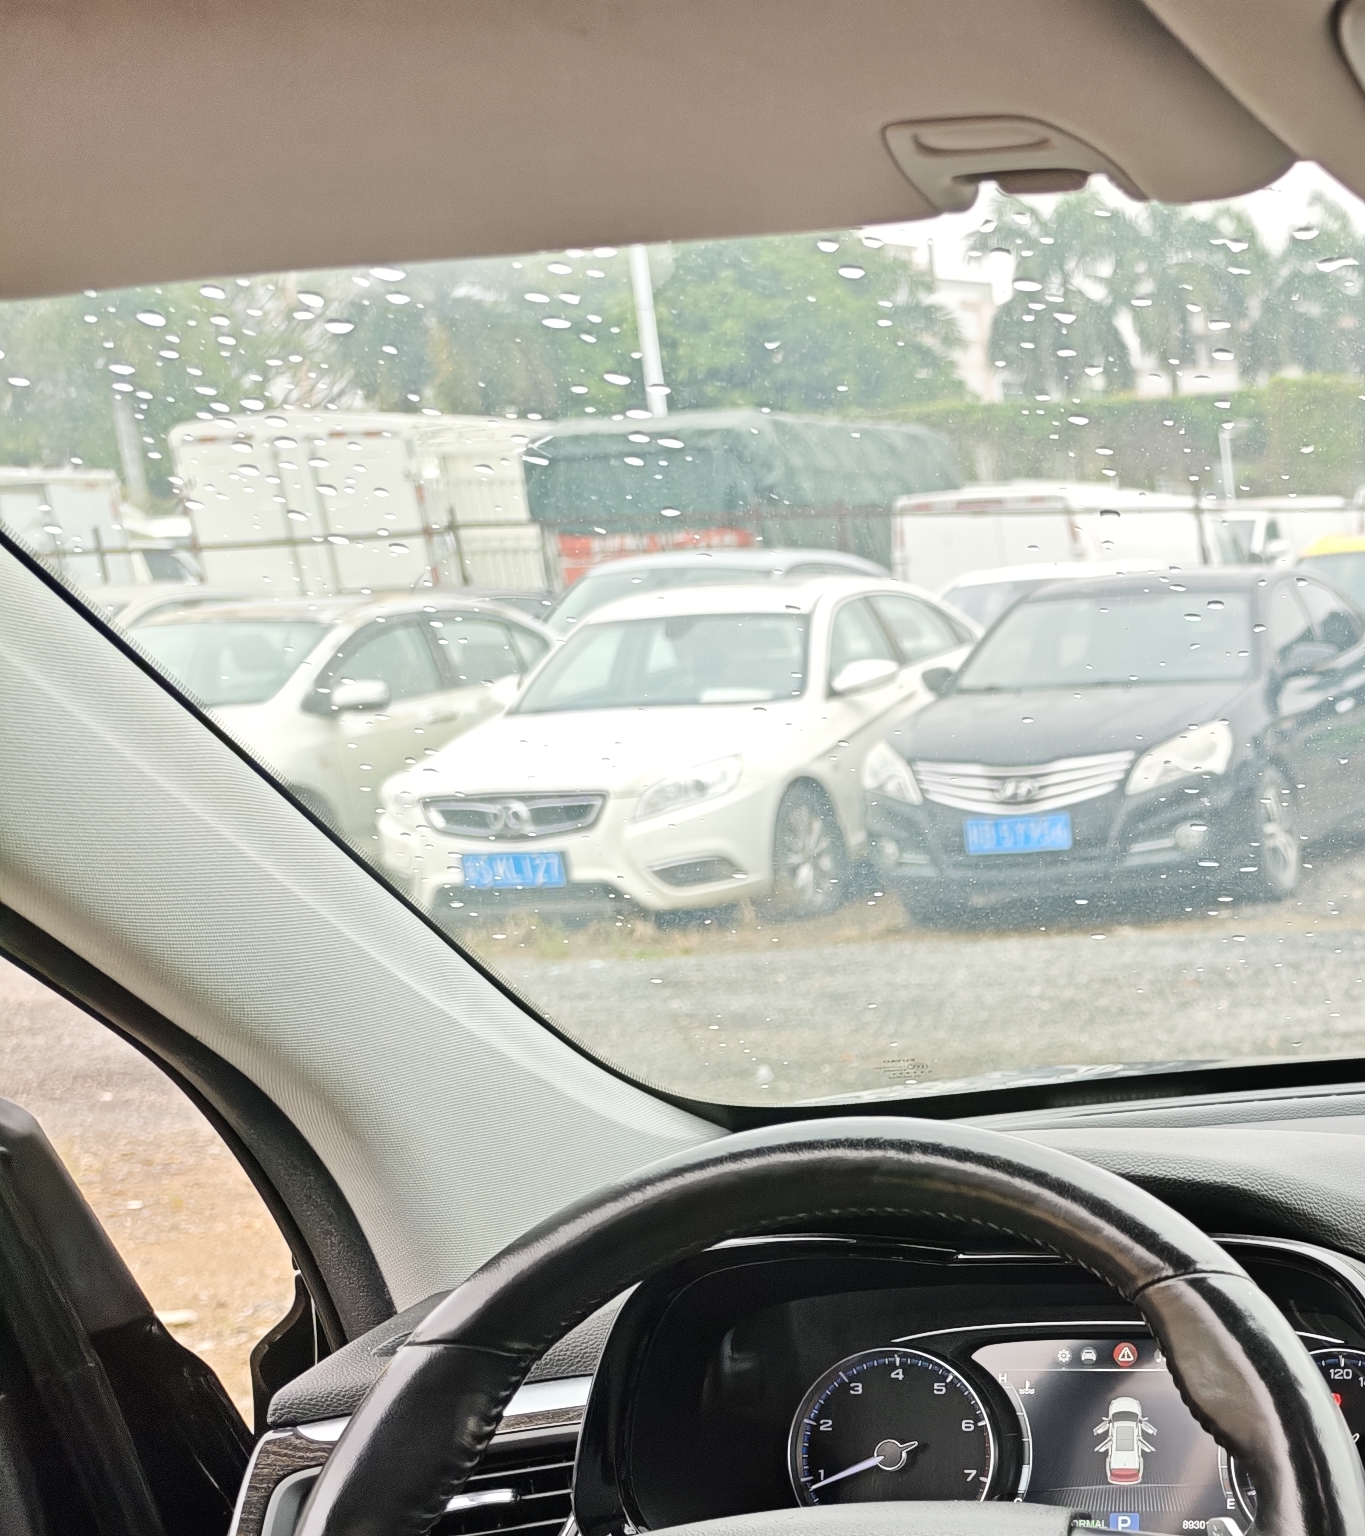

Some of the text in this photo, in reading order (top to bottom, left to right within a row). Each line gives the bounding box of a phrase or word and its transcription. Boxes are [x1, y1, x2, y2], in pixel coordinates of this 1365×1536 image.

[890, 1369, 905, 1380] 4
[1329, 1368, 1353, 1380] 120
[850, 1382, 863, 1395] 3
[933, 1382, 947, 1395] 5
[819, 1419, 833, 1431] 2
[961, 1419, 975, 1431] 6
[817, 1469, 826, 1480] 1
[963, 1469, 977, 1481] 7
[1226, 1498, 1236, 1510] E
[1117, 1516, 1132, 1531] P
